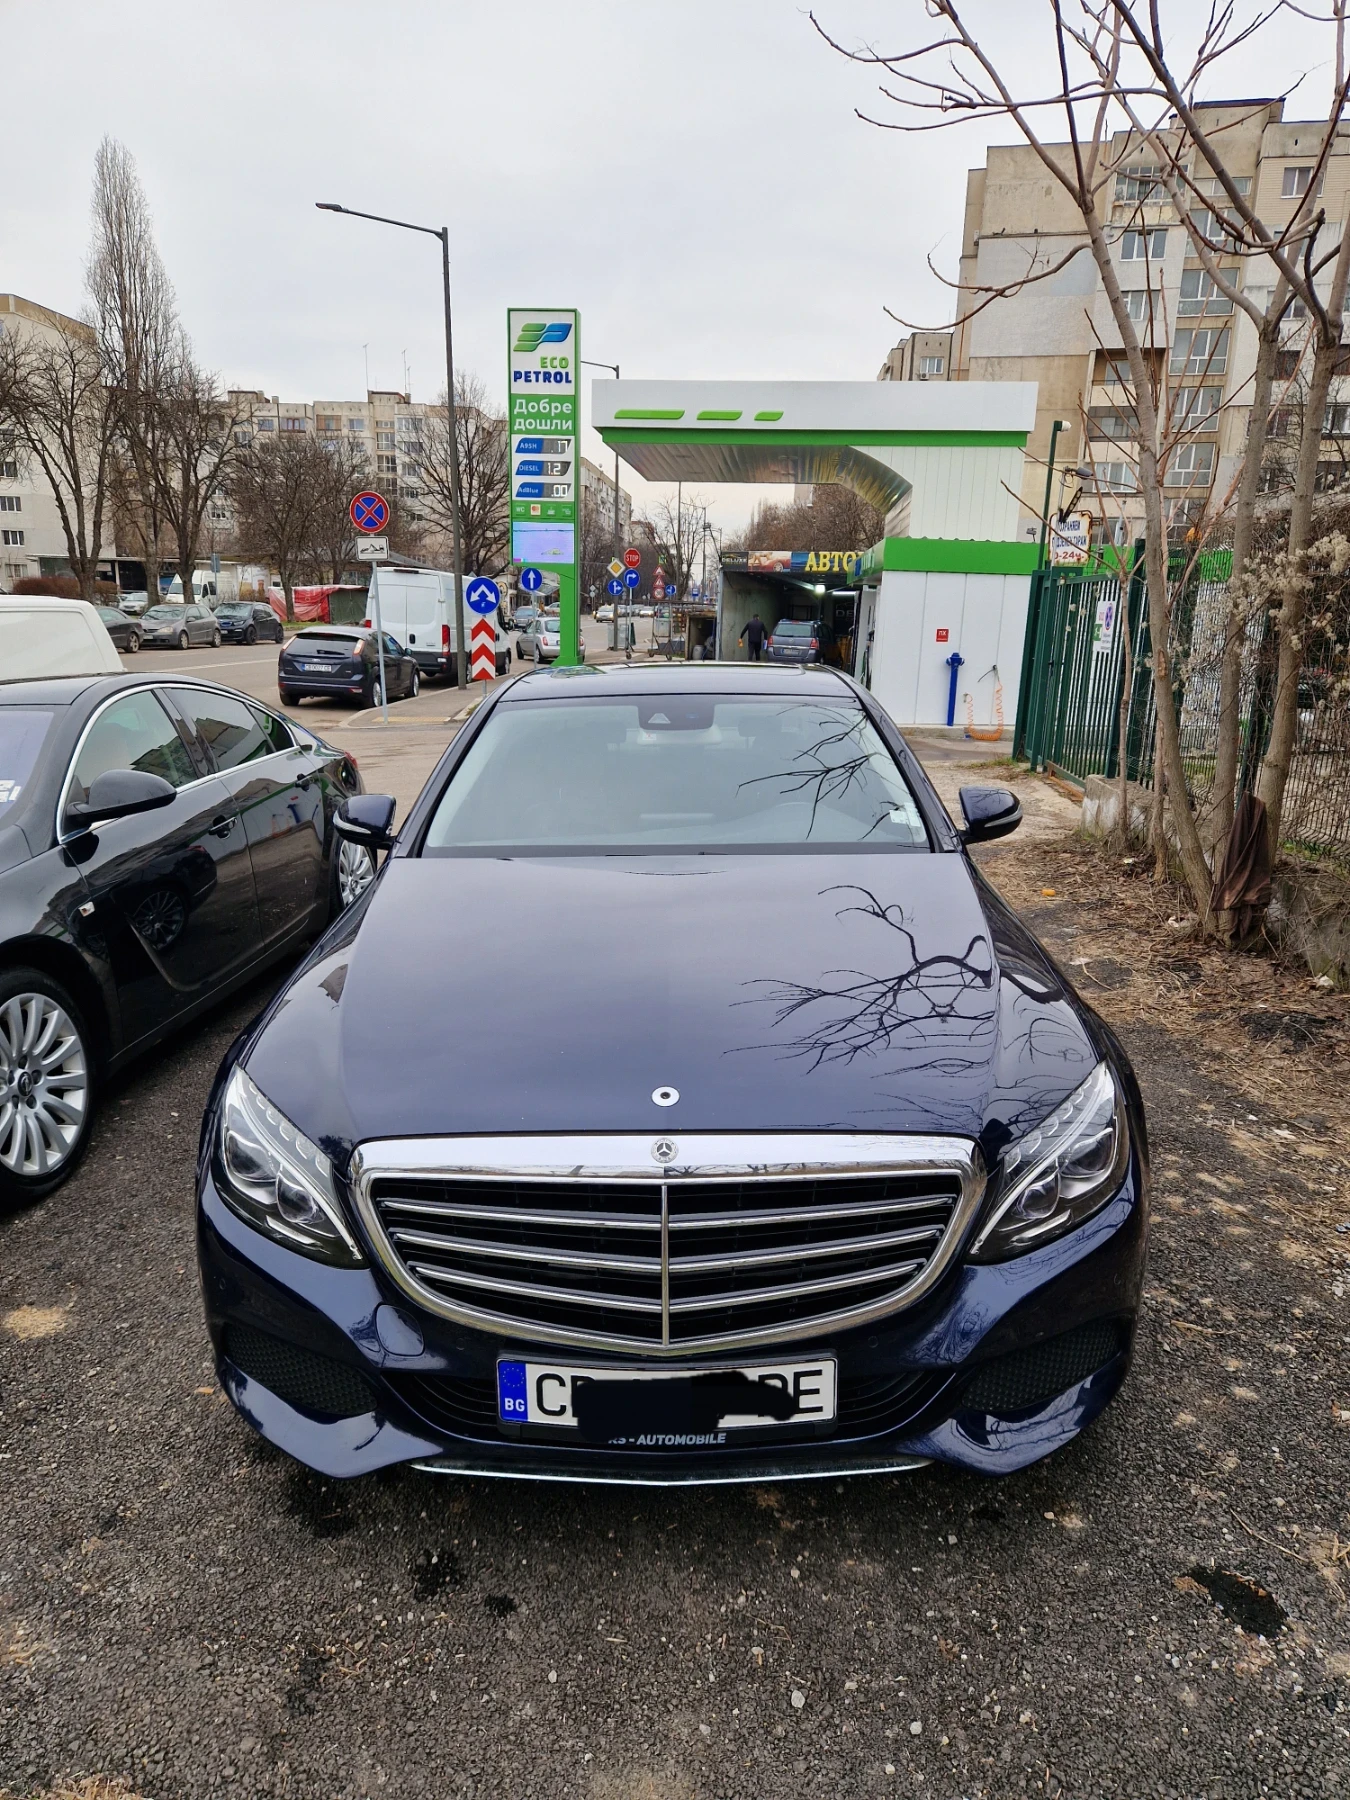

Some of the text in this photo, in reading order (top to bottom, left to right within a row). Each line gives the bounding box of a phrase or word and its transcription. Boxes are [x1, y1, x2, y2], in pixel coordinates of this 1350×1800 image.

[540, 356, 569, 369] ECO
[513, 370, 572, 384] PETROL
[513, 398, 572, 416] Добре
[514, 419, 572, 431] дошли
[519, 464, 540, 472] DIESEL
[504, 1397, 525, 1412] BG
[636, 1432, 727, 1446] AUTOMOBILE
